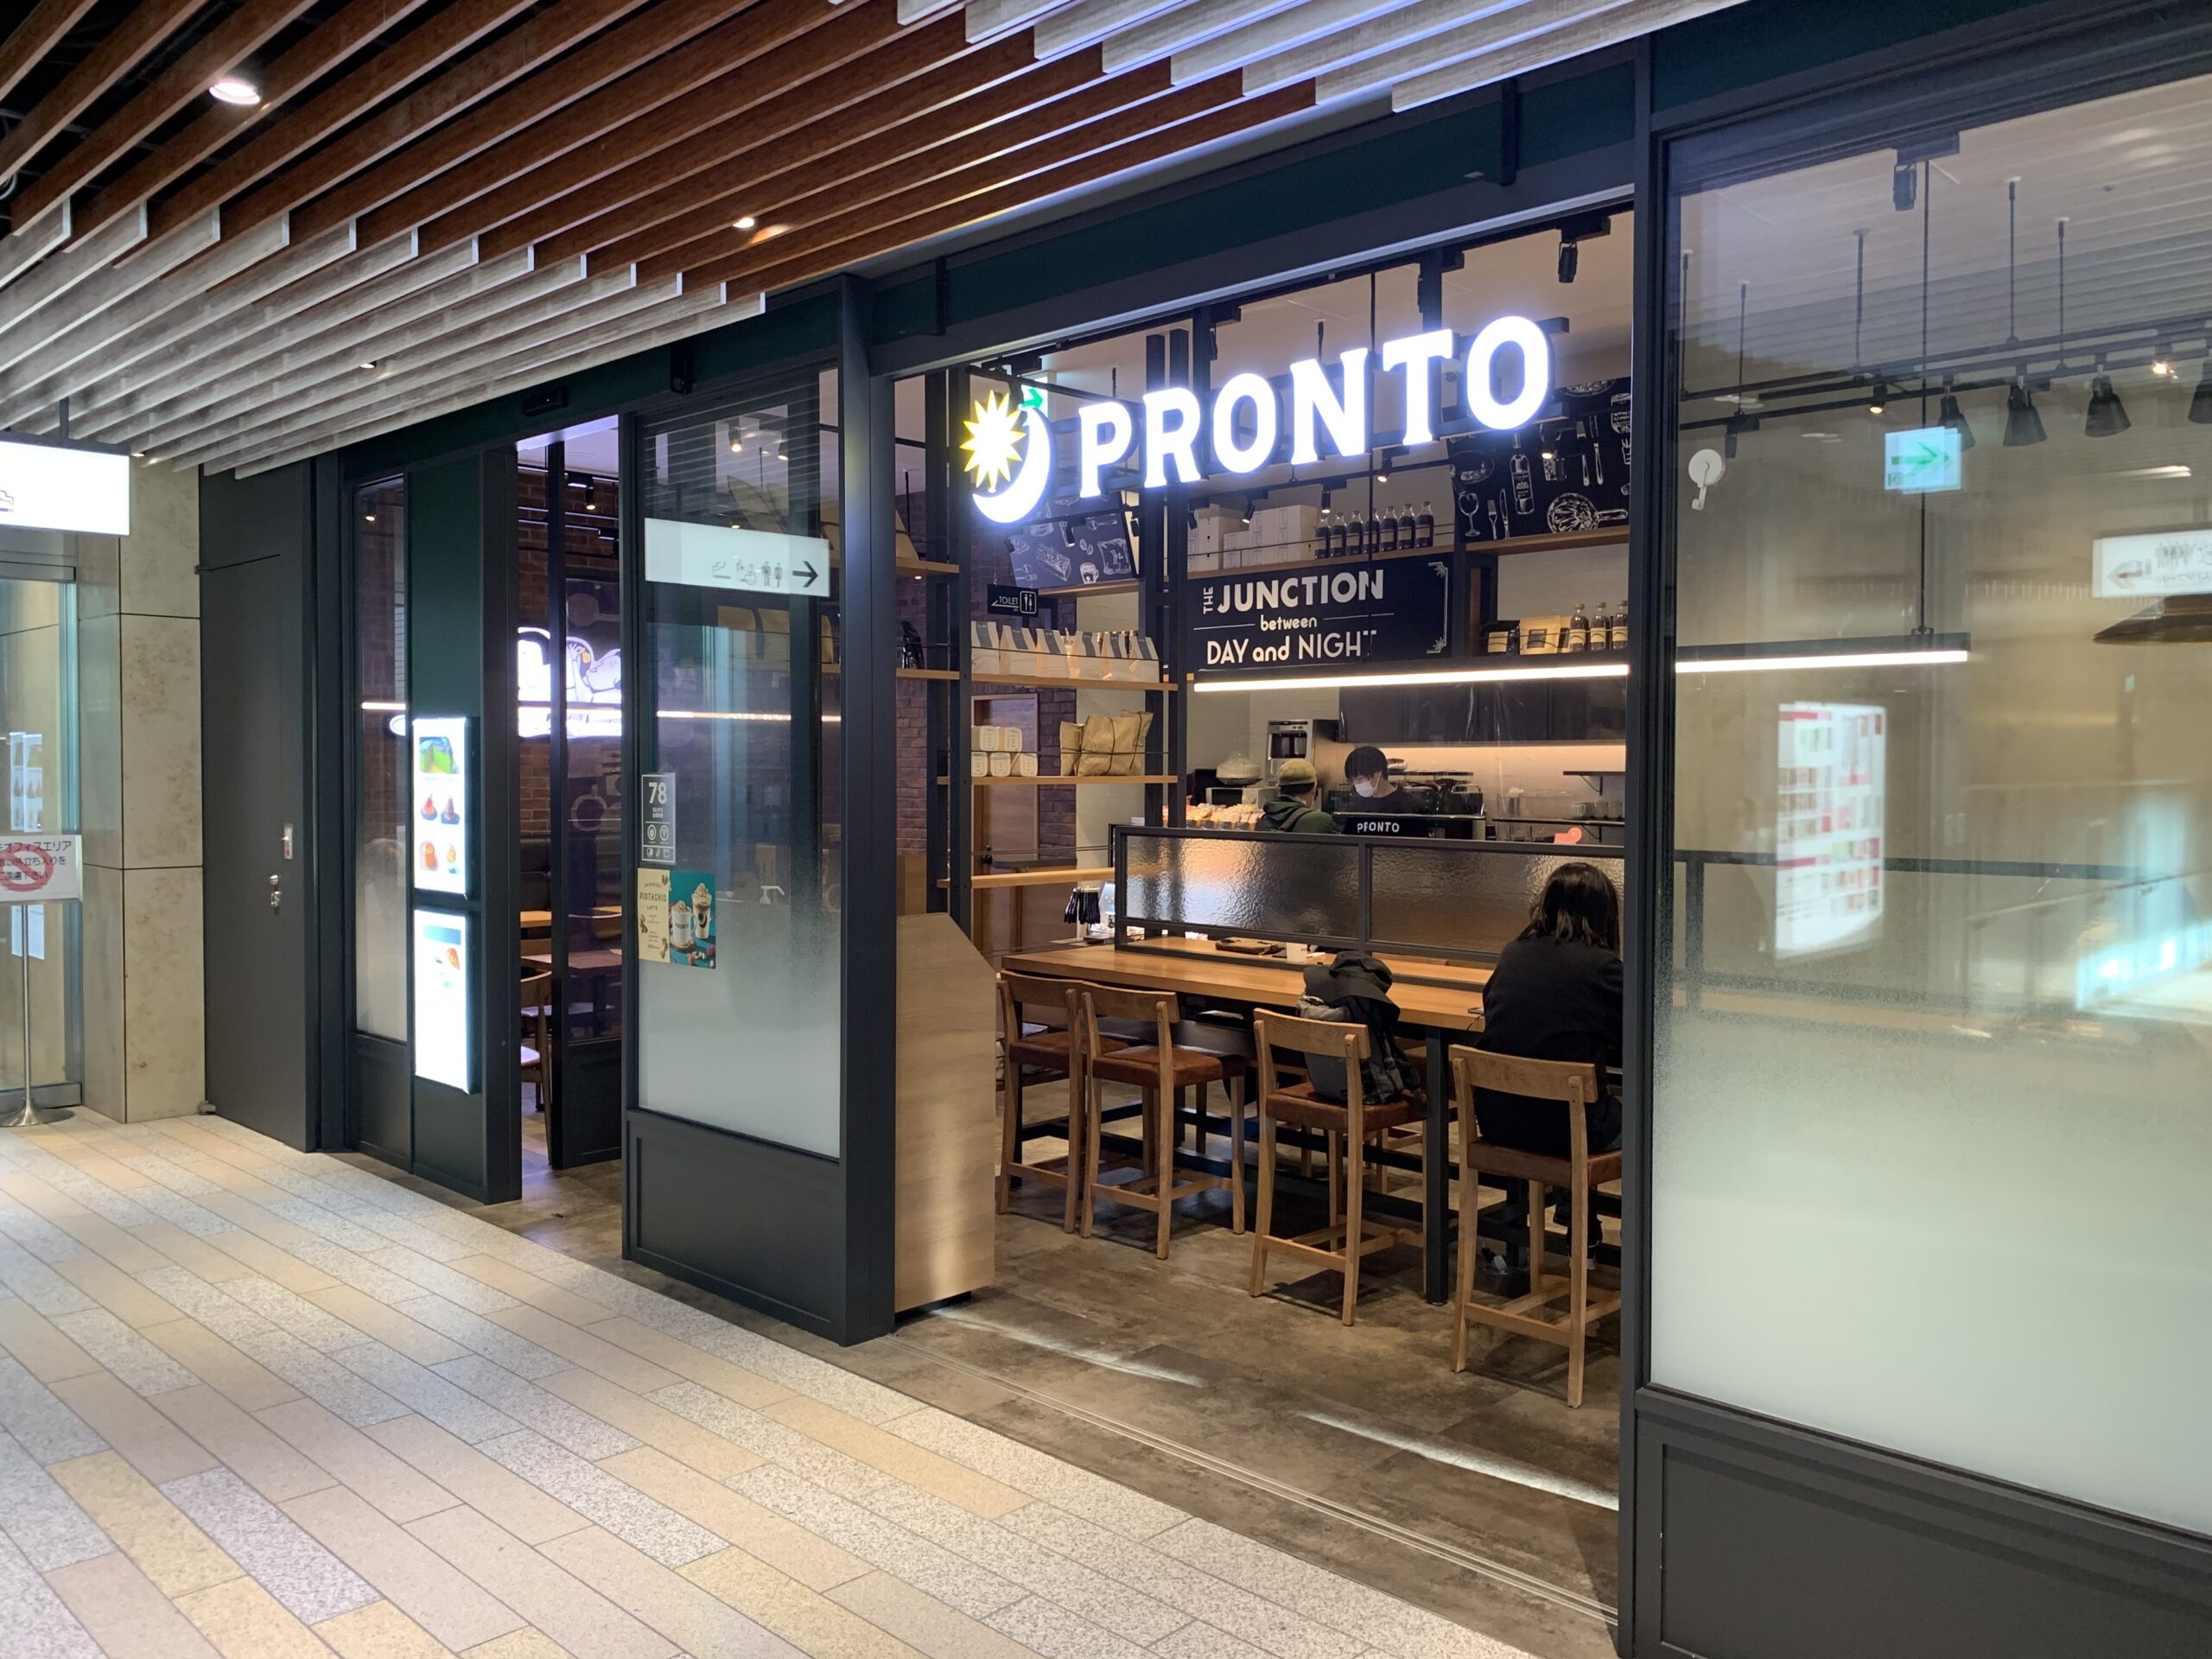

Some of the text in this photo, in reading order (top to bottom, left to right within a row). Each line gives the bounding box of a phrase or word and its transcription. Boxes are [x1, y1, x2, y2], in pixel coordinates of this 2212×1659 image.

[1077, 315, 1550, 499] PRONTO
[998, 595, 1020, 606] TOILET
[1203, 586, 1214, 615] THE
[1217, 569, 1384, 614] JUNCTION
[1260, 614, 1318, 632] between
[1206, 638, 1249, 665] DAY
[1252, 635, 1290, 663] and
[648, 781, 668, 804] 78
[639, 892, 667, 902] PISTACHIO
